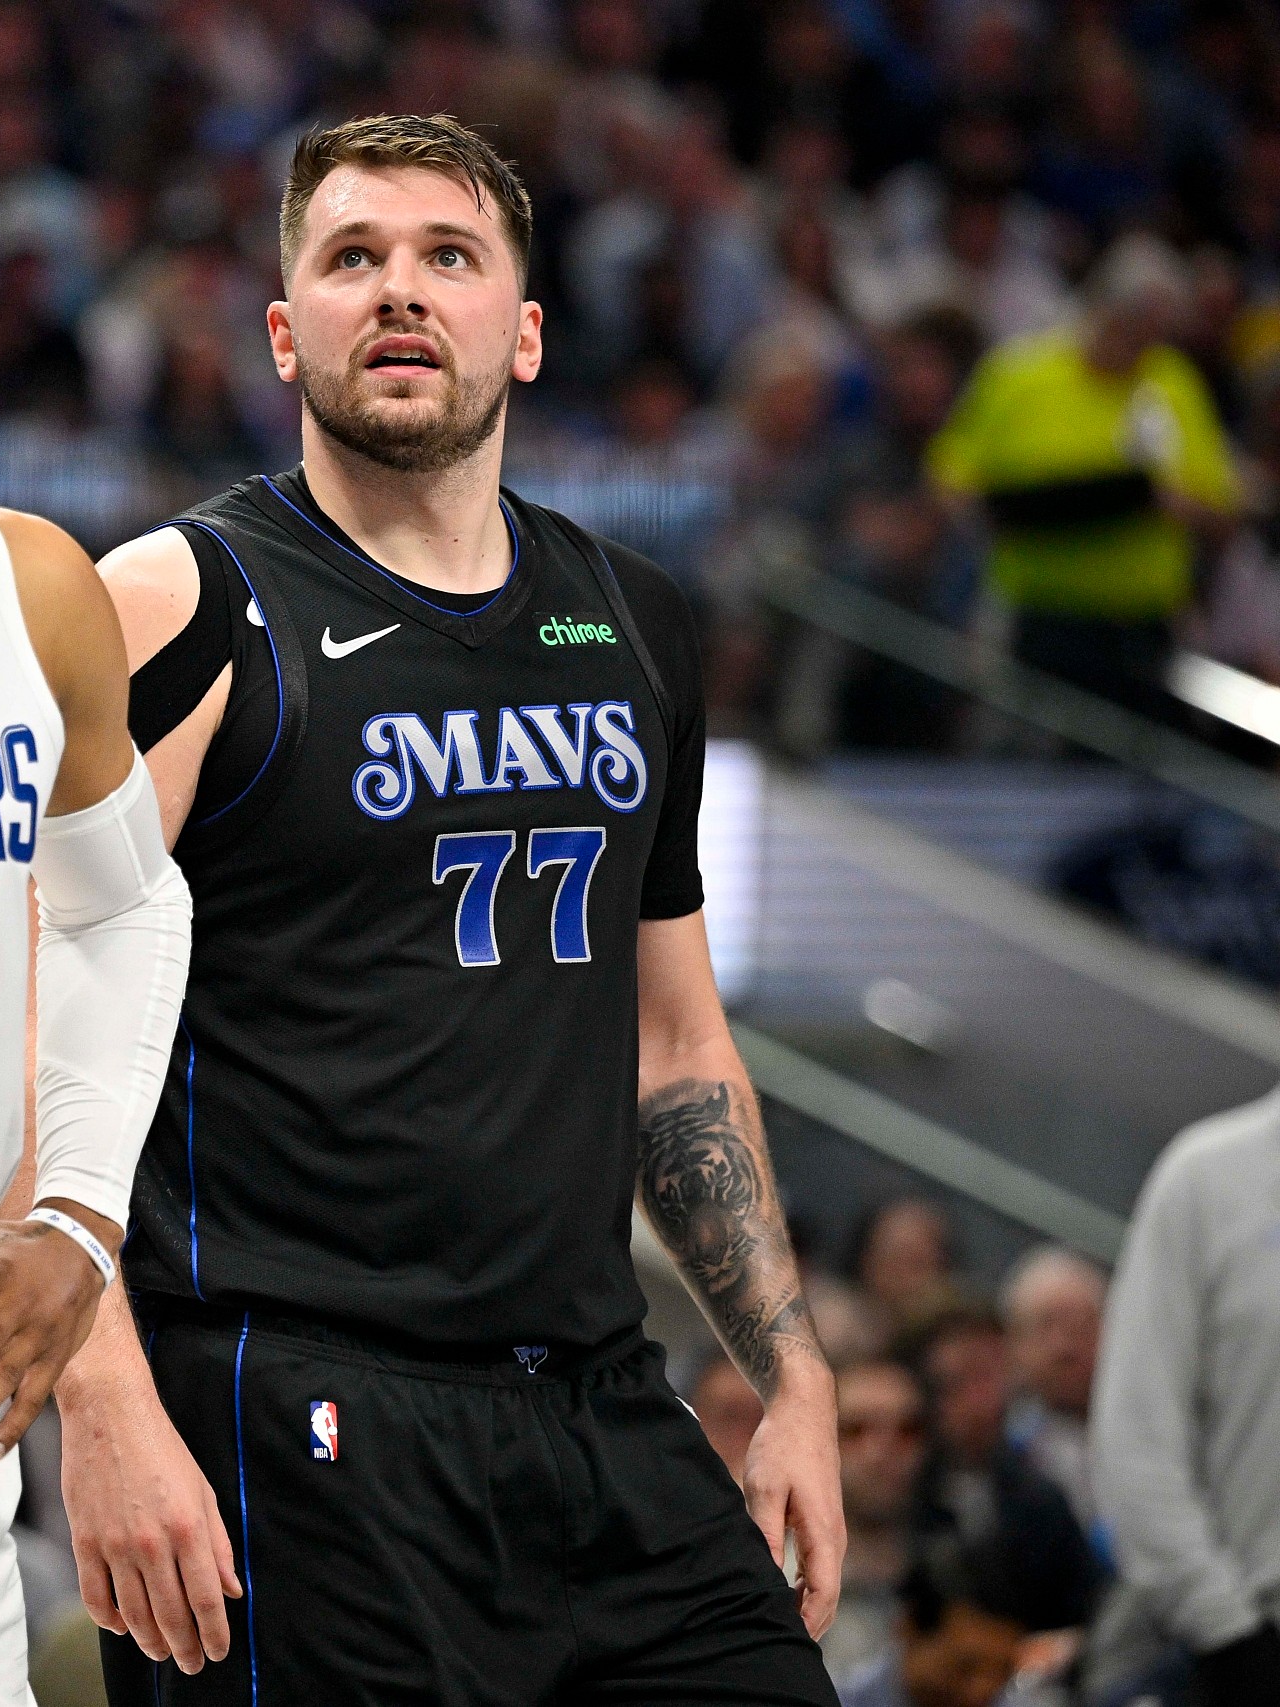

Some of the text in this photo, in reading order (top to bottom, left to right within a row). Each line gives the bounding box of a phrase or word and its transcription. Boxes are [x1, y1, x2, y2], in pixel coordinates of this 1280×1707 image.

[539, 616, 617, 646] chime
[351, 701, 648, 822] MAVS
[432, 826, 607, 968] 77
[314, 1447, 329, 1459] NBA
